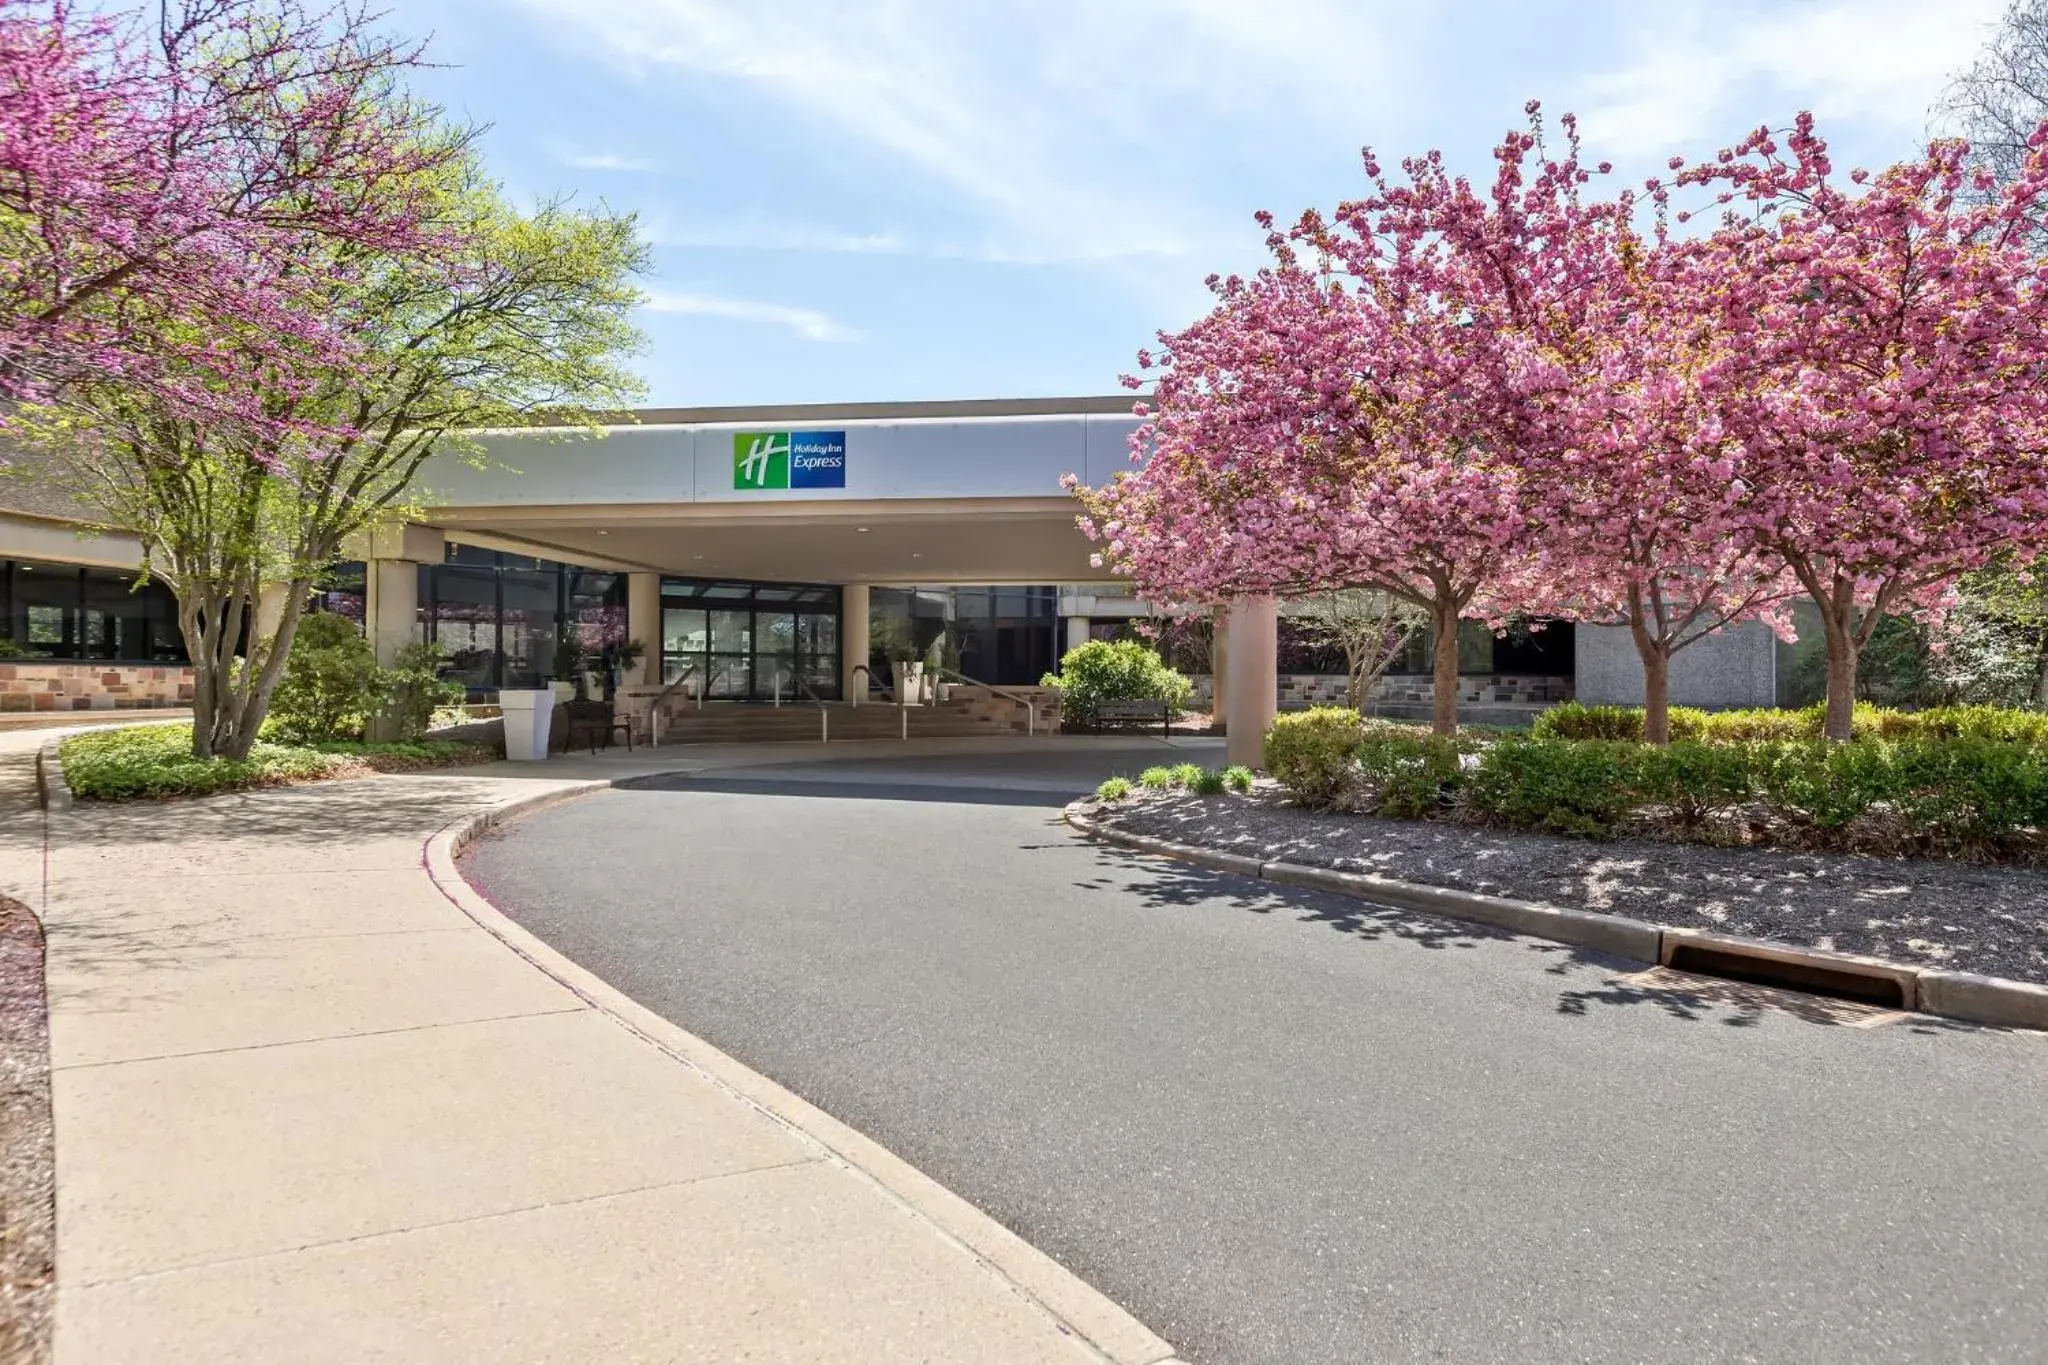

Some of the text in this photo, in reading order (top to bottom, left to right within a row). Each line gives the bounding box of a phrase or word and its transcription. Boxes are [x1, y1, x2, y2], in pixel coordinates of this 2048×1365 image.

[794, 443, 842, 455] Holiday Inn
[738, 435, 789, 486] H
[794, 455, 843, 471] Express
